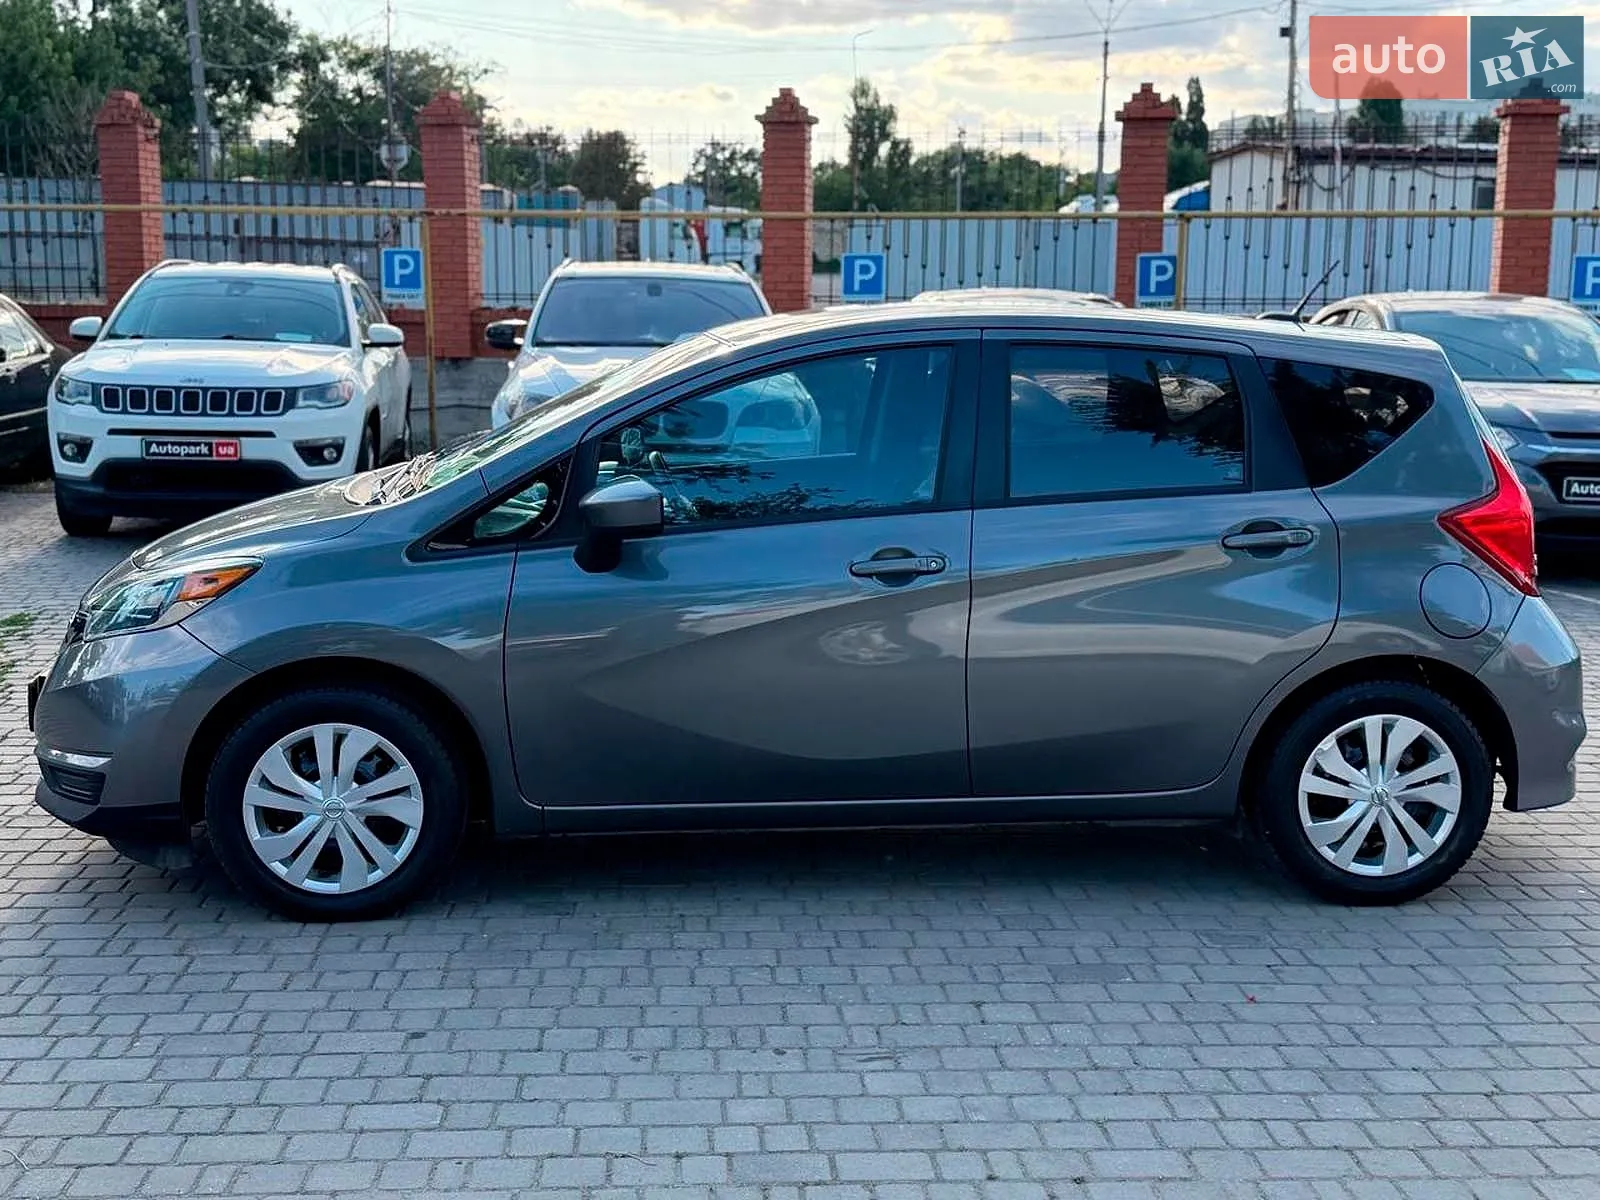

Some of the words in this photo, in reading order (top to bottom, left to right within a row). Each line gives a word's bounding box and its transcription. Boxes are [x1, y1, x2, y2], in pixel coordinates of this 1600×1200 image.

[394, 254, 415, 286] P
[854, 259, 876, 291] P
[1150, 260, 1174, 293] P
[150, 442, 210, 456] Autopark
[218, 445, 236, 455] ua
